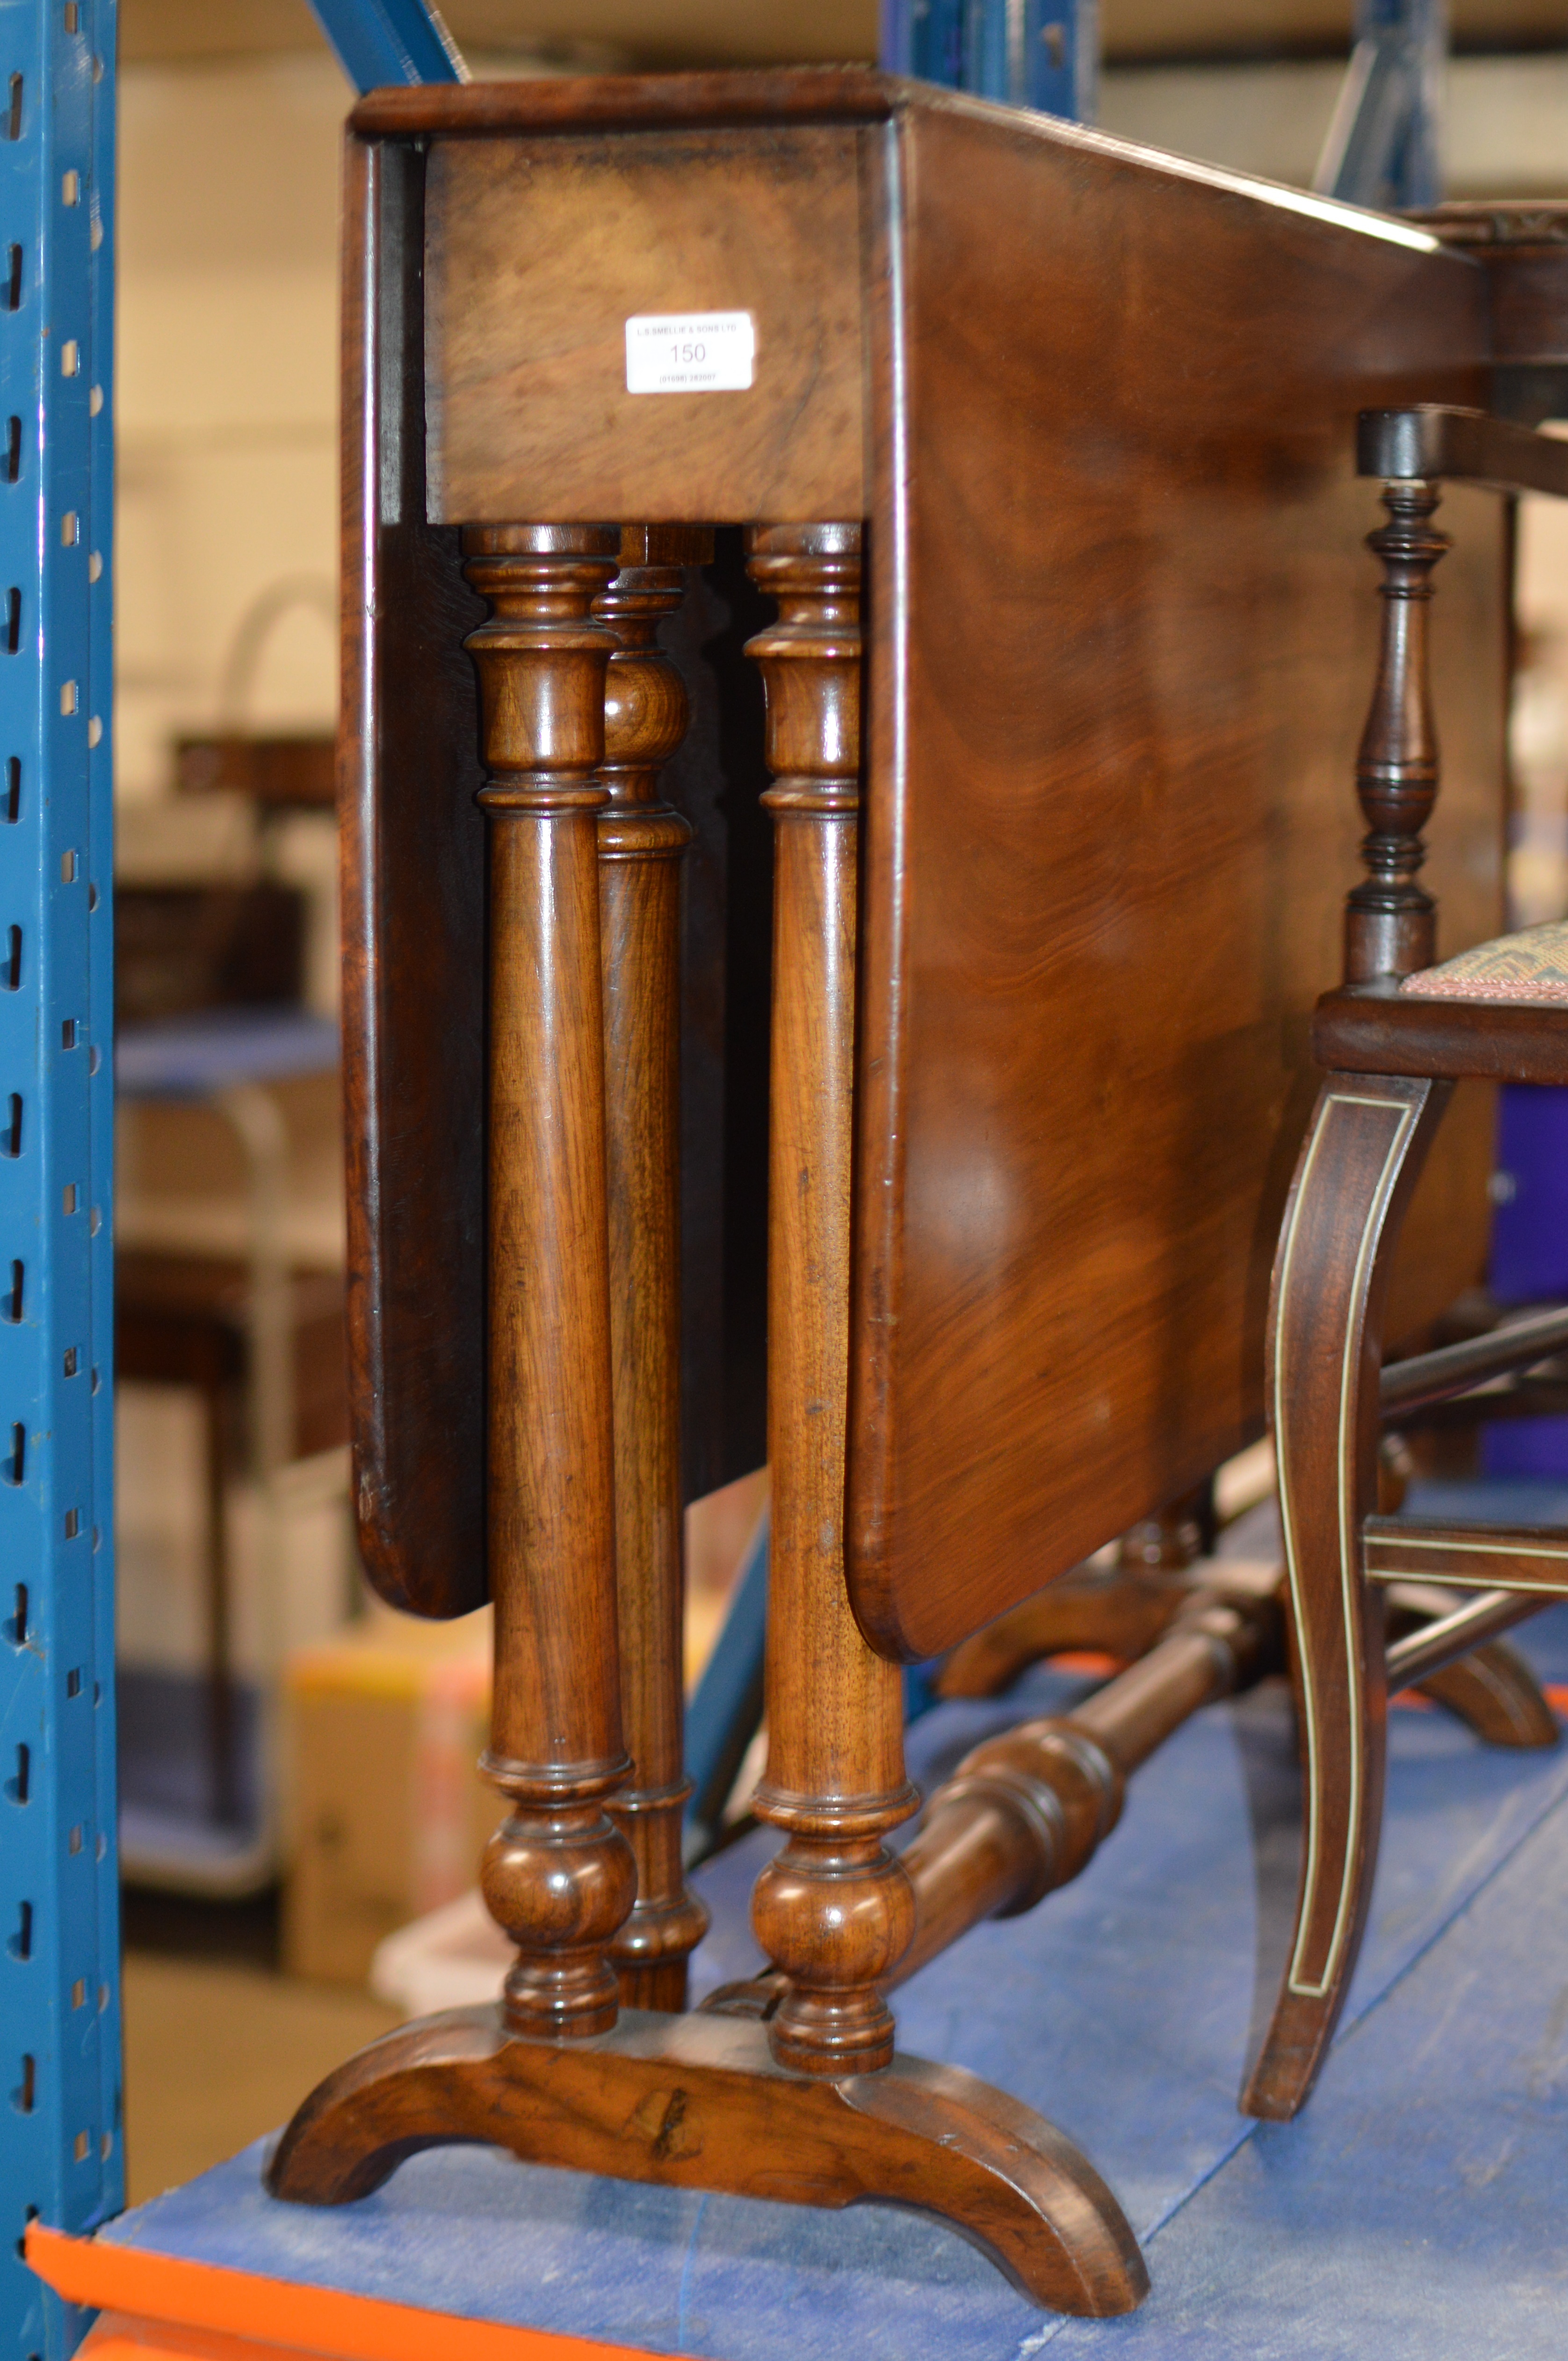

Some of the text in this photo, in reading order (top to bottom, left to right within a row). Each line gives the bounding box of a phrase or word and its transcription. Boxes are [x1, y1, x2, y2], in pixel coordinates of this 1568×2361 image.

[697, 325, 719, 333] SONS
[722, 324, 737, 332] LTD
[671, 343, 706, 363] 150
[659, 375, 687, 384] (01698)
